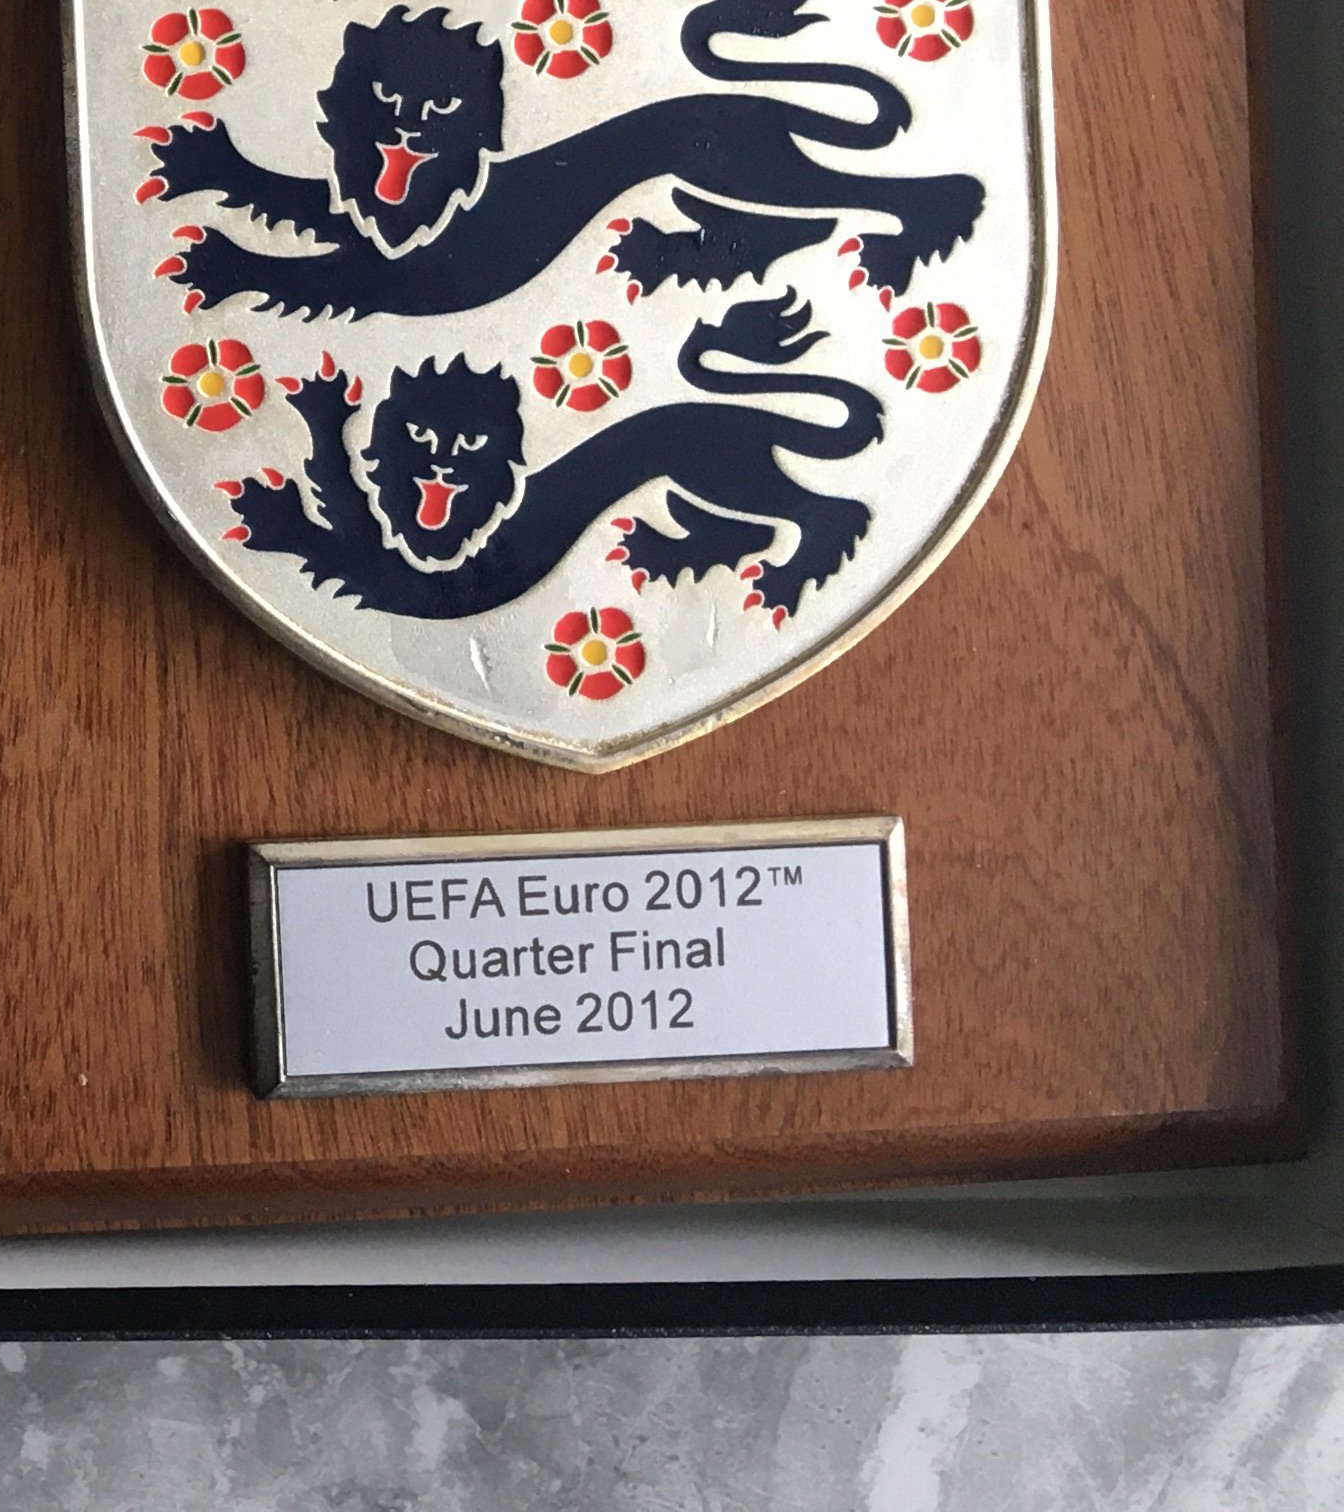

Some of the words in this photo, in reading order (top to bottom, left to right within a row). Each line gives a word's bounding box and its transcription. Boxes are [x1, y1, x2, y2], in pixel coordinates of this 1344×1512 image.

[366, 877, 506, 923] UEFA
[518, 875, 629, 916] Euro
[409, 937, 595, 983] Quarter
[610, 926, 725, 972] Final
[444, 998, 561, 1040] June
[576, 988, 694, 1033] 2012
